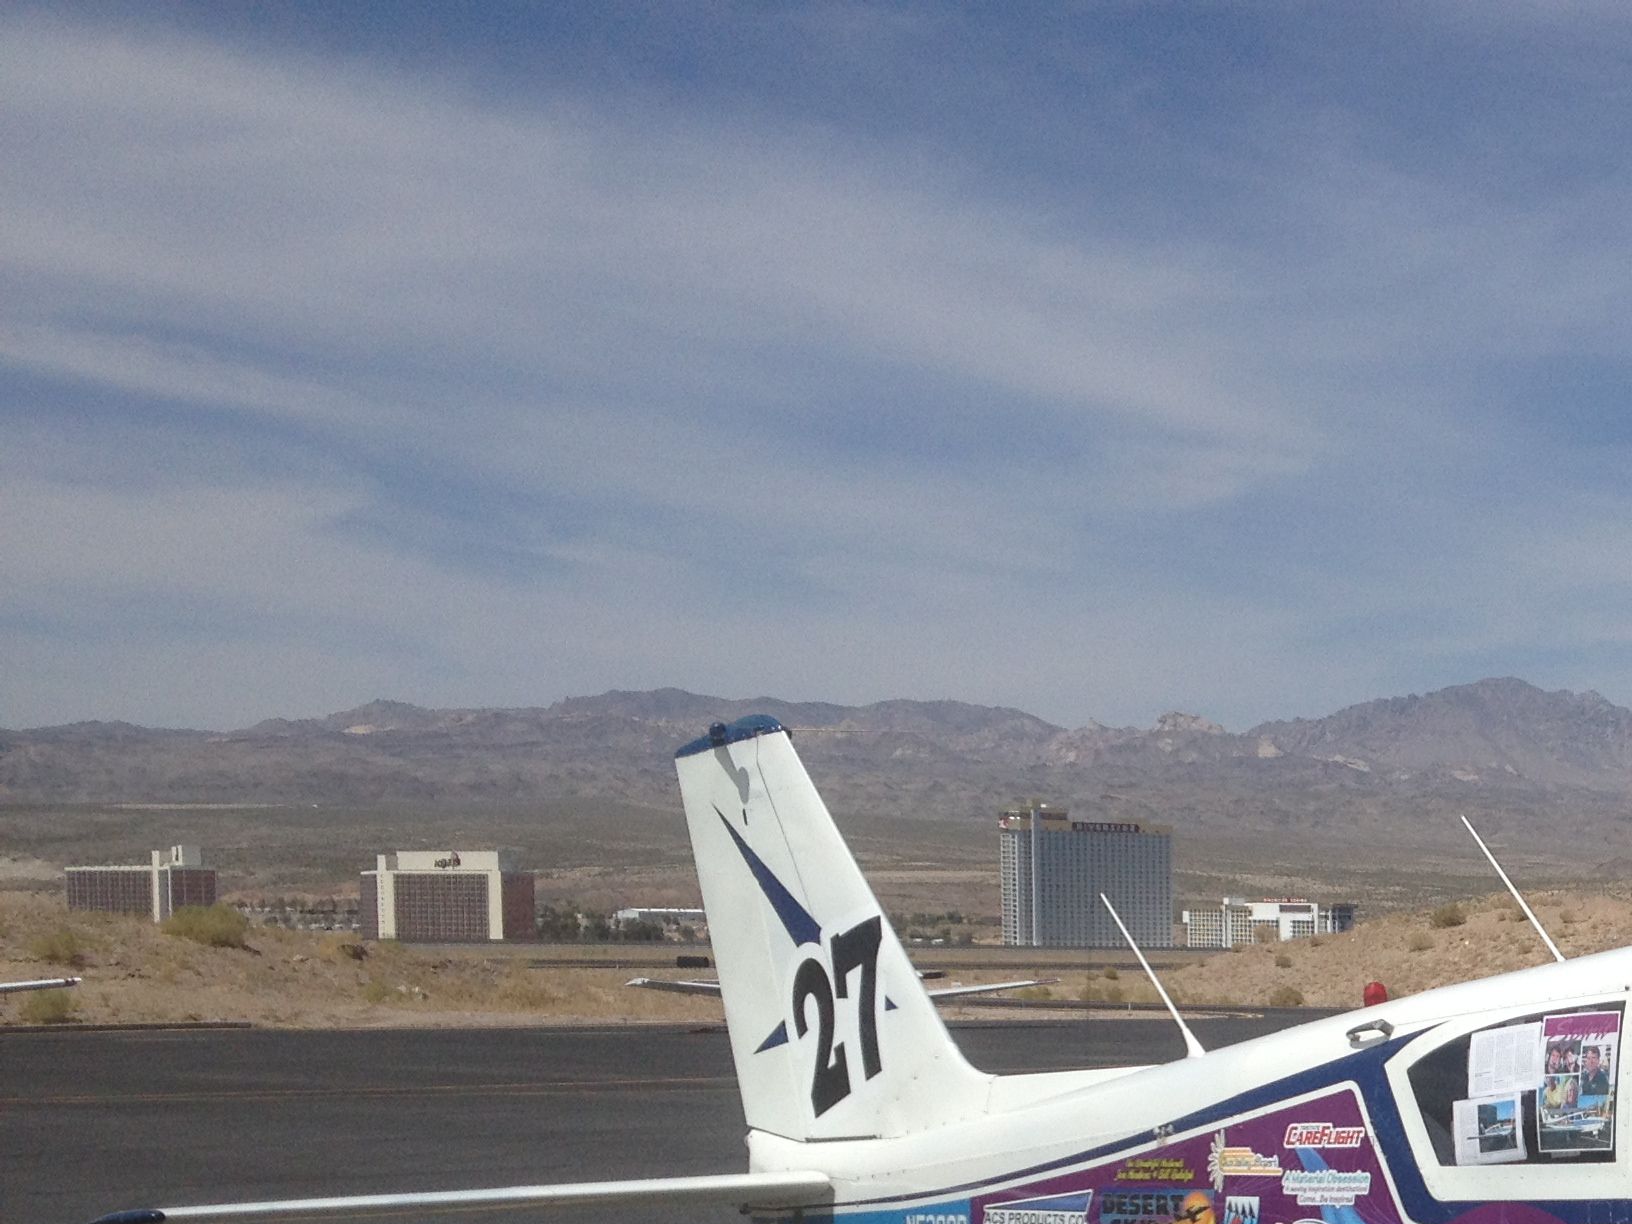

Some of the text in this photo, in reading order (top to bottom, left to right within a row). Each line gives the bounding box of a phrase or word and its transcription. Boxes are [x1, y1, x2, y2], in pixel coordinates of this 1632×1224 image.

[793, 915, 882, 1118] 27
[1103, 1194, 1184, 1215] DESERT
[984, 1211, 1005, 1224] ACS
